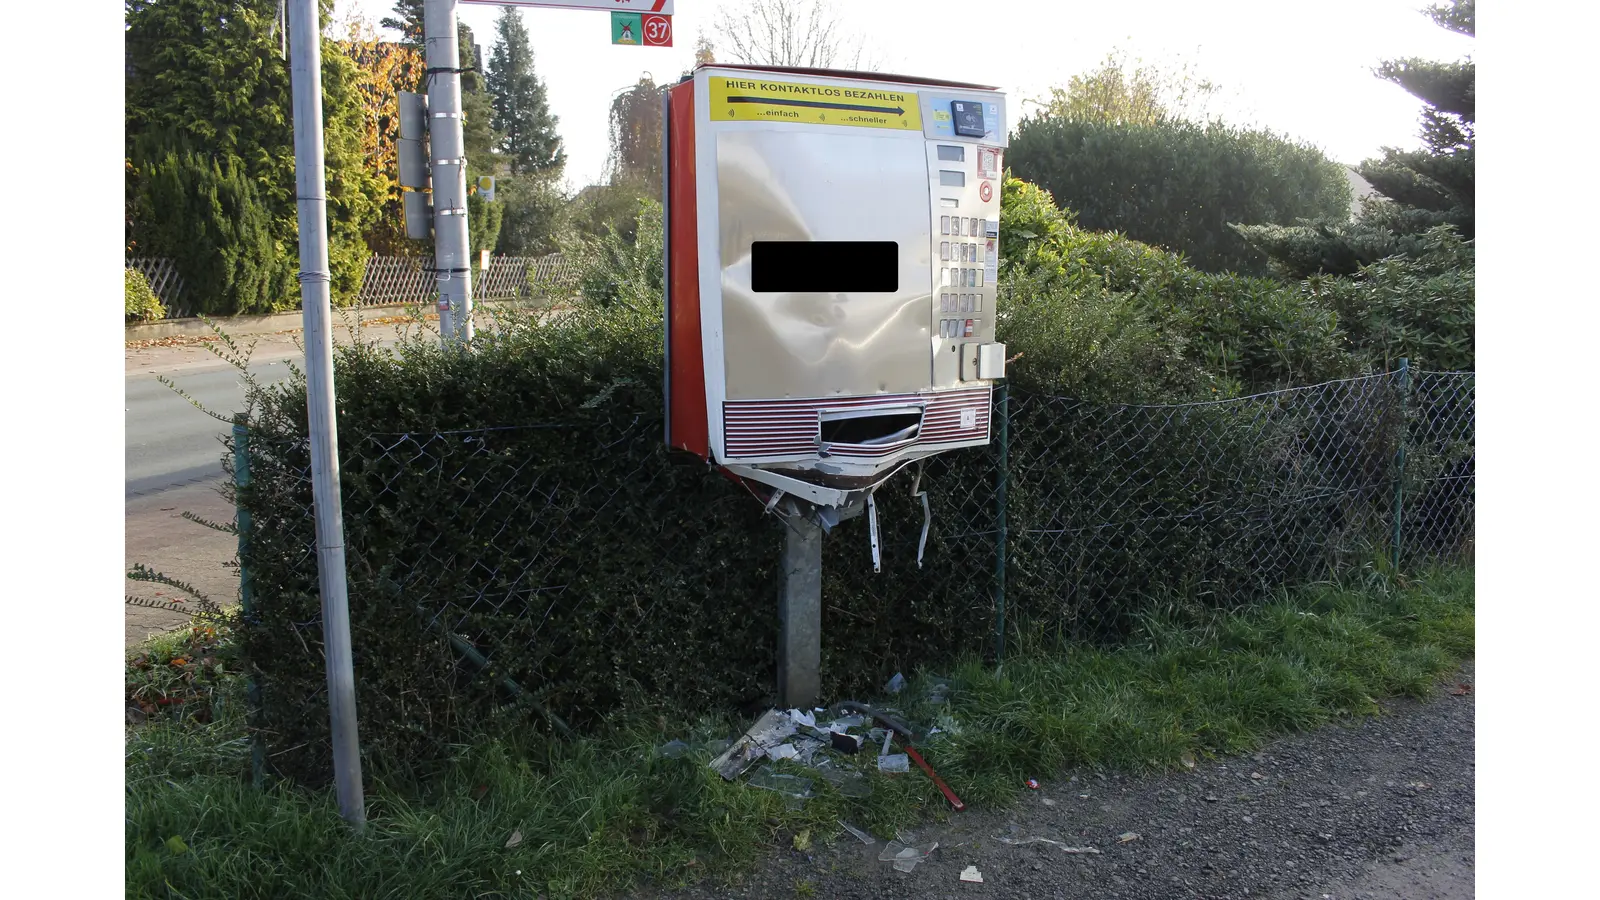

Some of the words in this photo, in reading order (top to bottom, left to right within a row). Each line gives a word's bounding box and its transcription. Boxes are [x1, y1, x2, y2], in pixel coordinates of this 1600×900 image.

[648, 22, 667, 39] 37
[726, 80, 756, 90] HIER
[760, 83, 841, 97] KONTAKTLOS
[844, 90, 905, 102] BEZAHLEN
